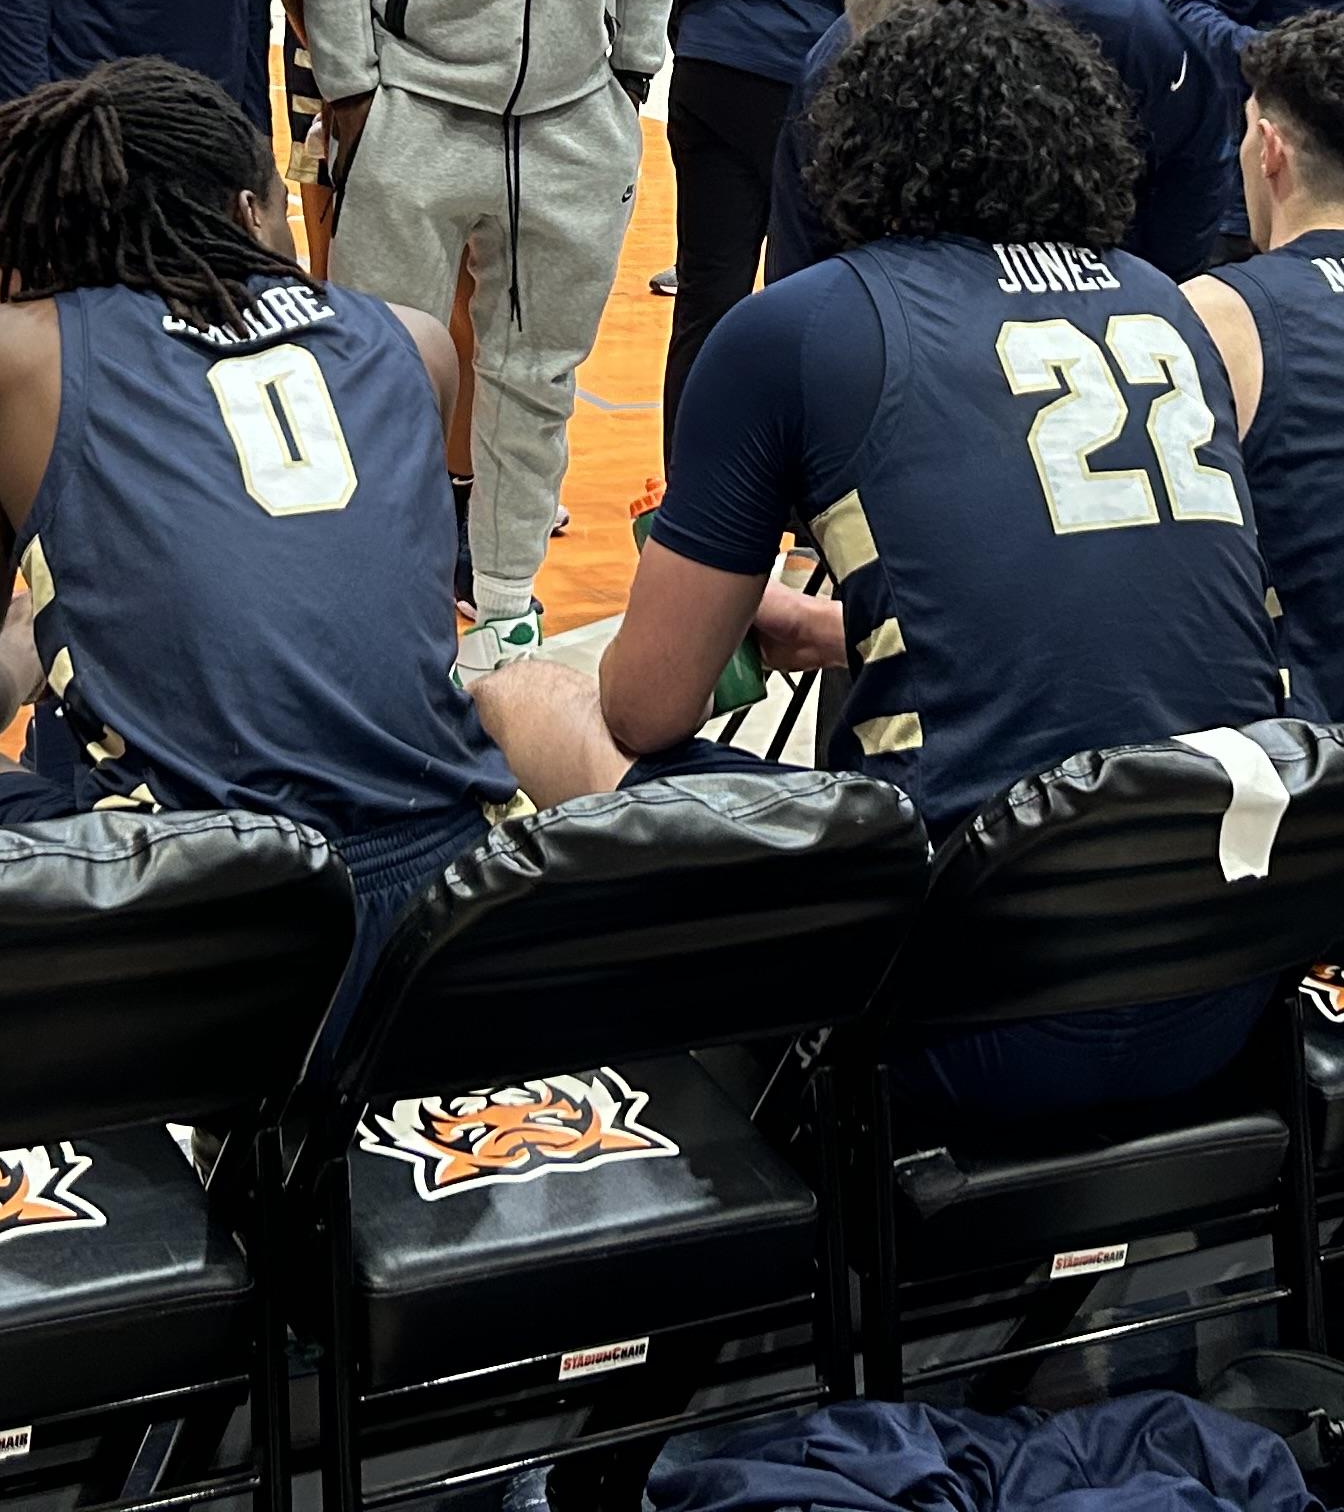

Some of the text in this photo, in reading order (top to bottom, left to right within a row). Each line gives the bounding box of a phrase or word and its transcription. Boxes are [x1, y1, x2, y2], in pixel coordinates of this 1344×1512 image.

[992, 241, 1121, 293] JONES
[206, 343, 358, 518] 0
[996, 313, 1244, 535] 22
